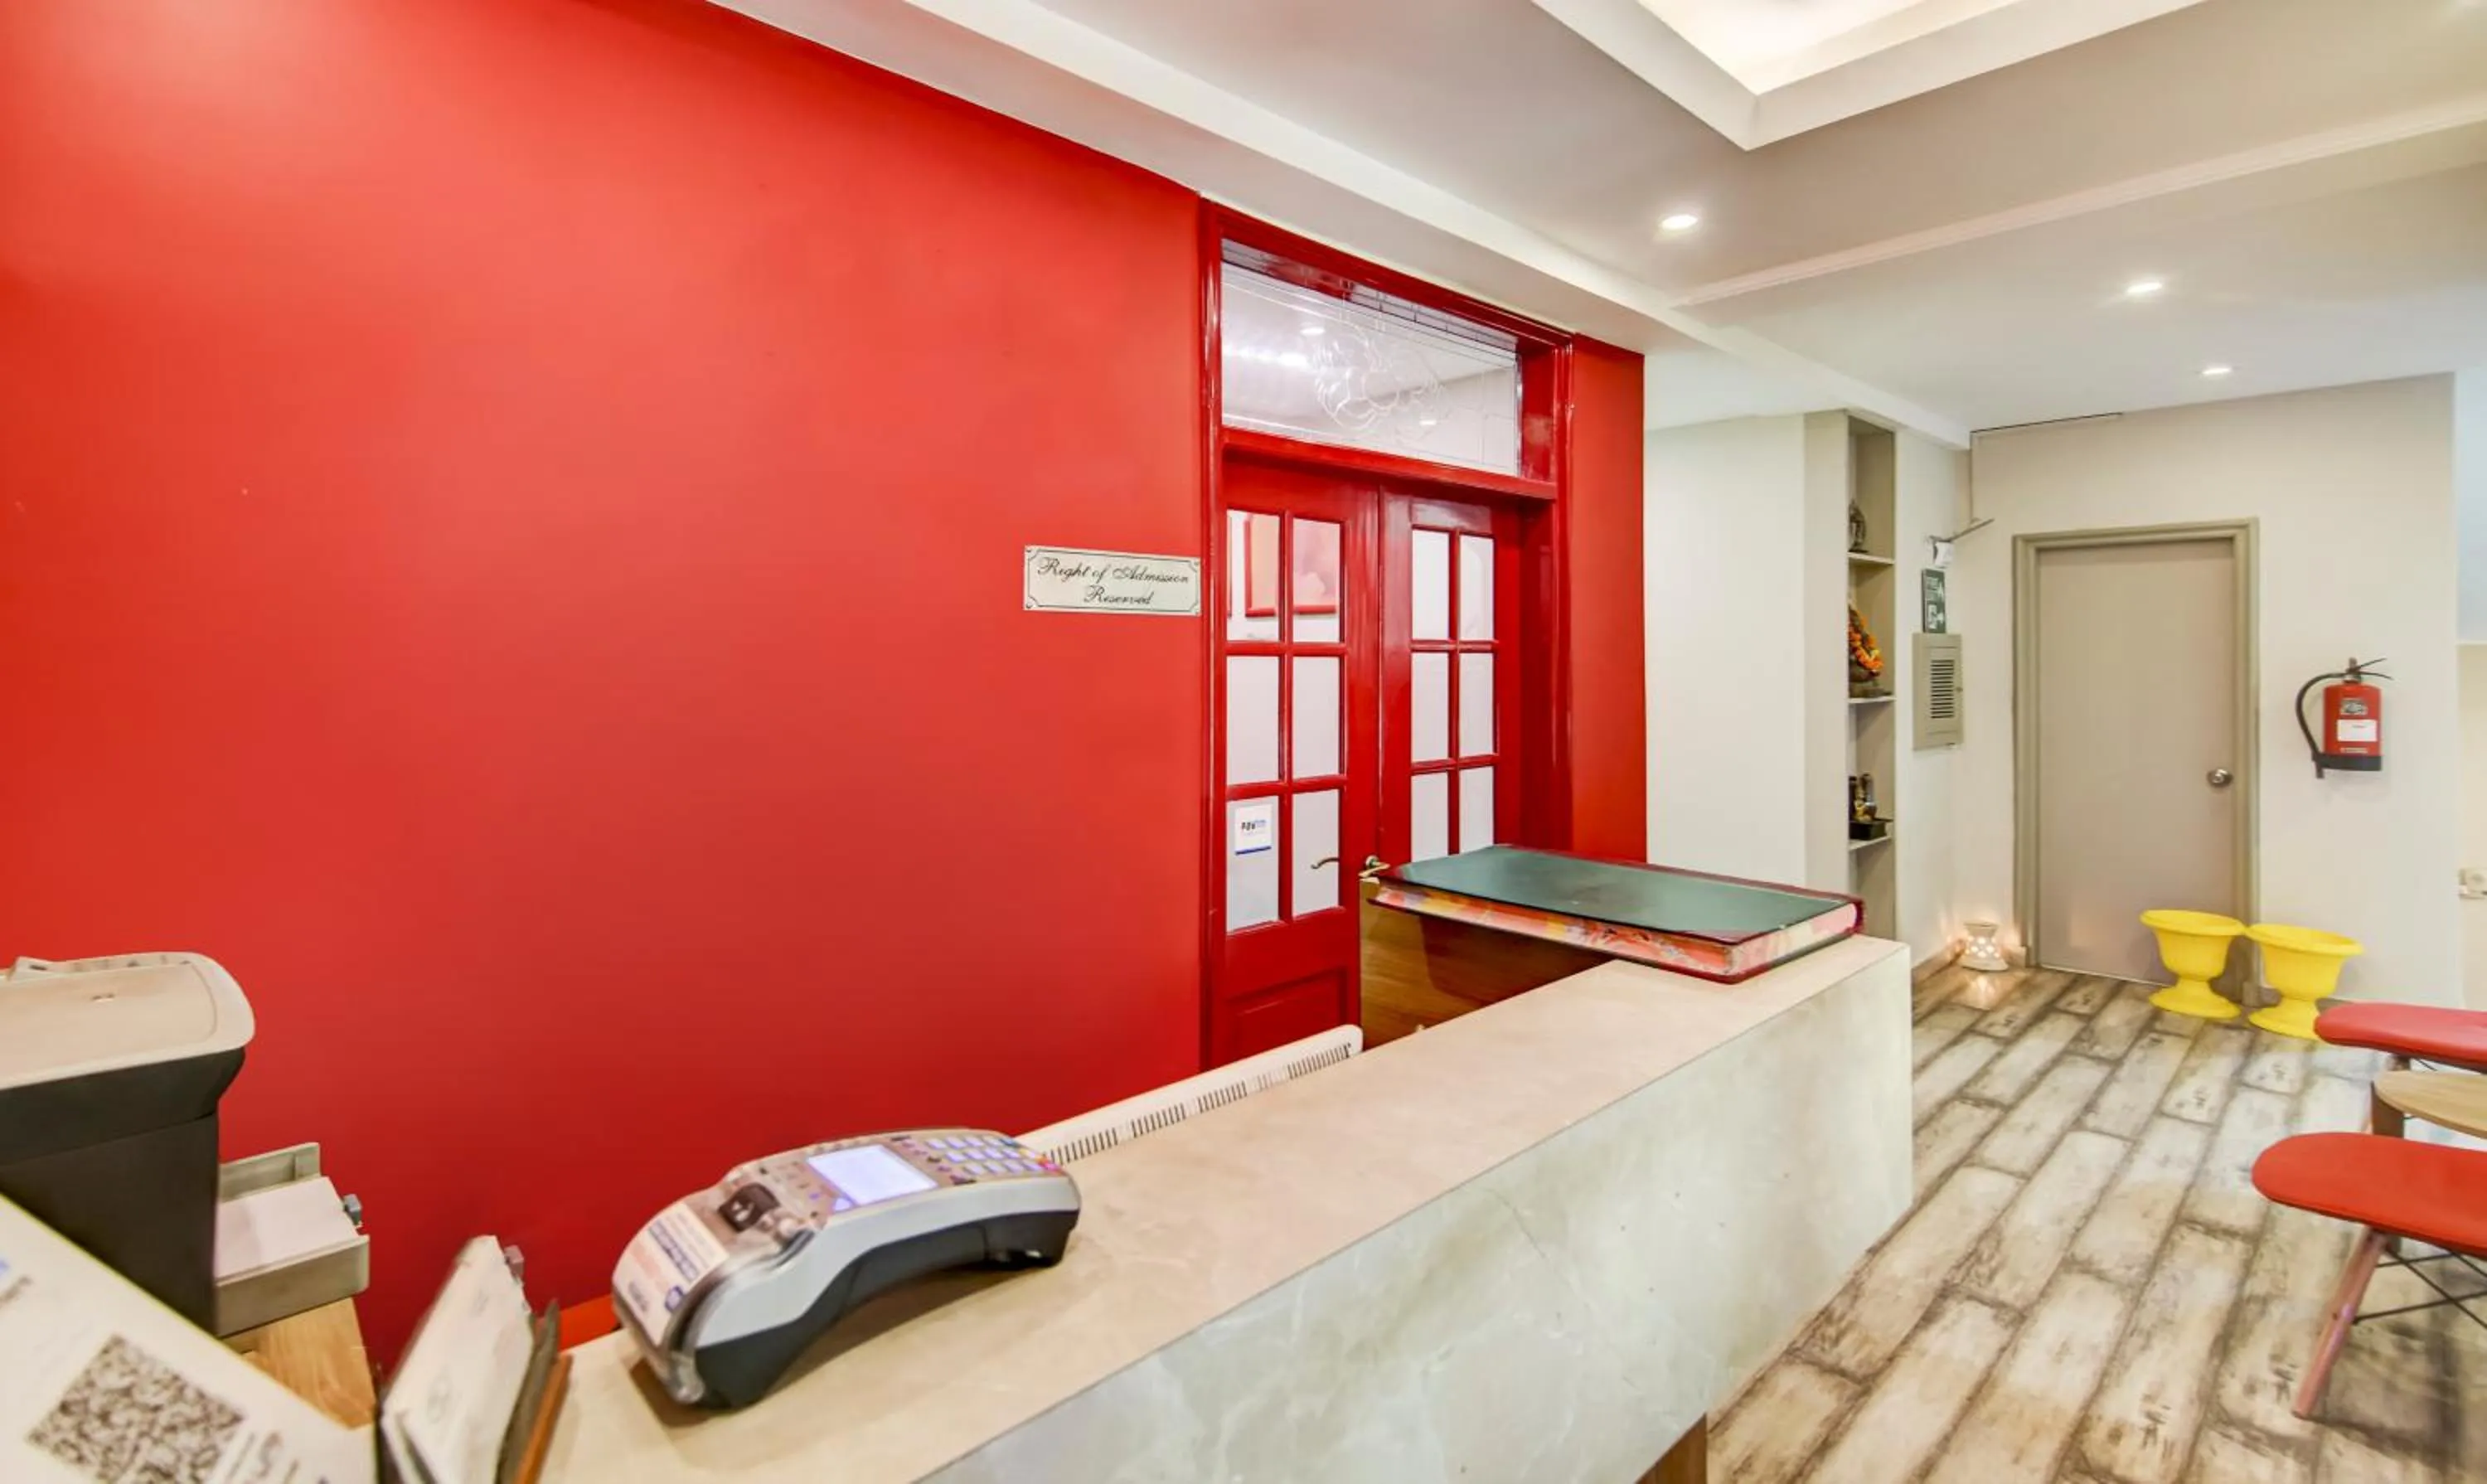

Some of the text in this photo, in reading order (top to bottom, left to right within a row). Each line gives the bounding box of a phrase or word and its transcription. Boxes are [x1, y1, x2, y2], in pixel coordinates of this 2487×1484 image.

[1037, 556, 1189, 584] Right of Admission
[1084, 584, 1155, 605] Reserved
